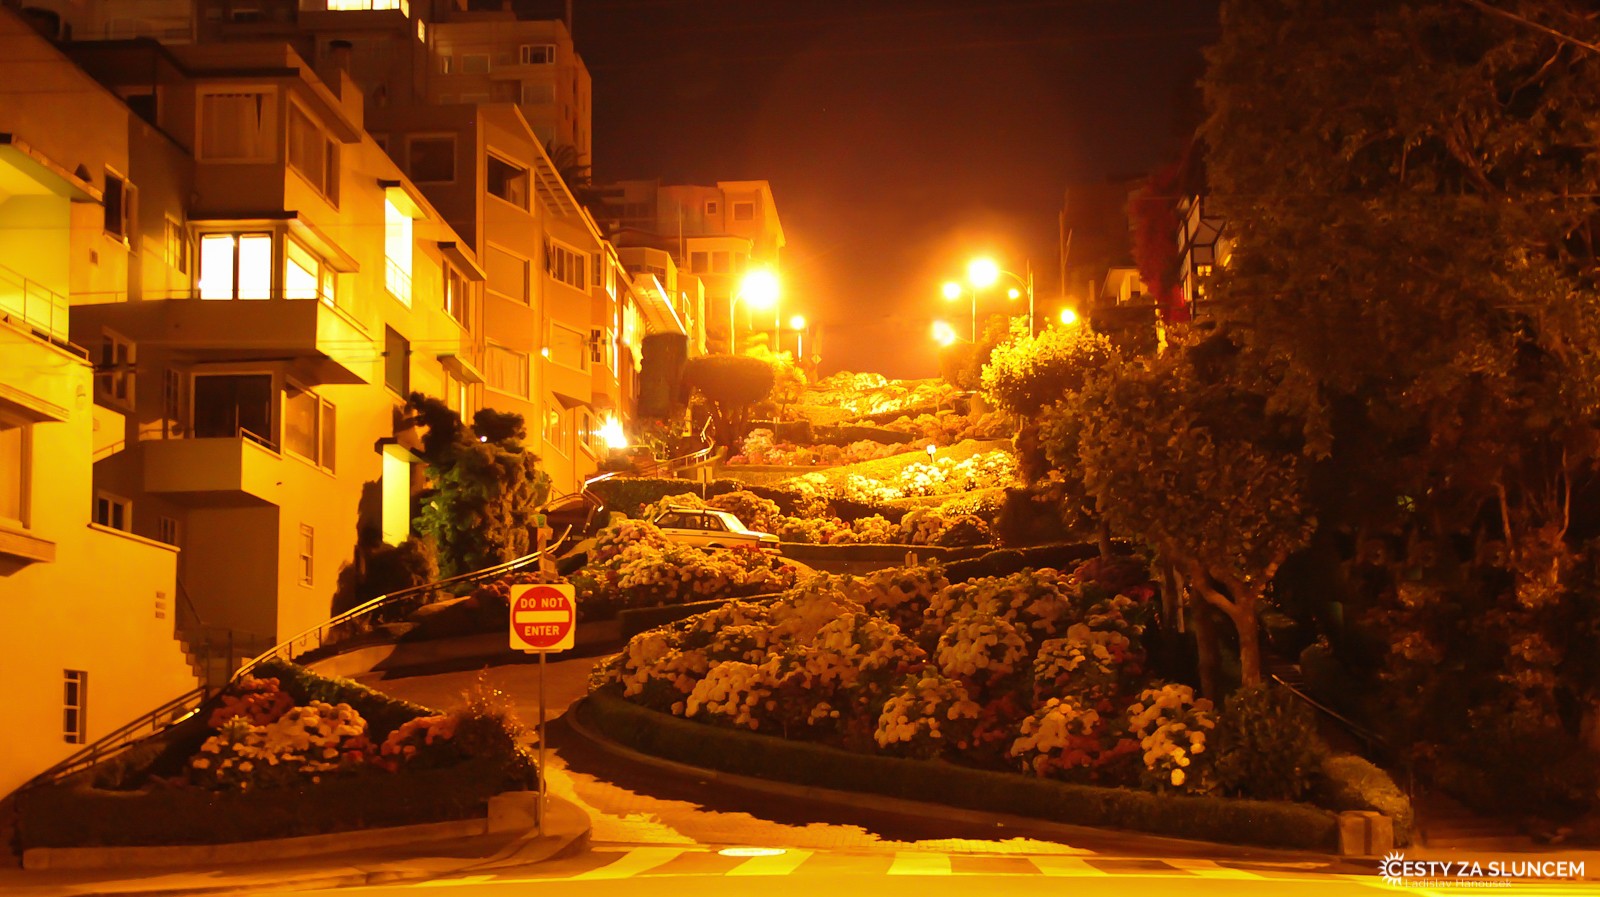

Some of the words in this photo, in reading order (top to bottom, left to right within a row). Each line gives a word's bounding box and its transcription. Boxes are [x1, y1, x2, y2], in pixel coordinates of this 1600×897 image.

[520, 598, 536, 608] DO
[541, 597, 563, 607] NOT
[524, 625, 559, 636] ENTER
